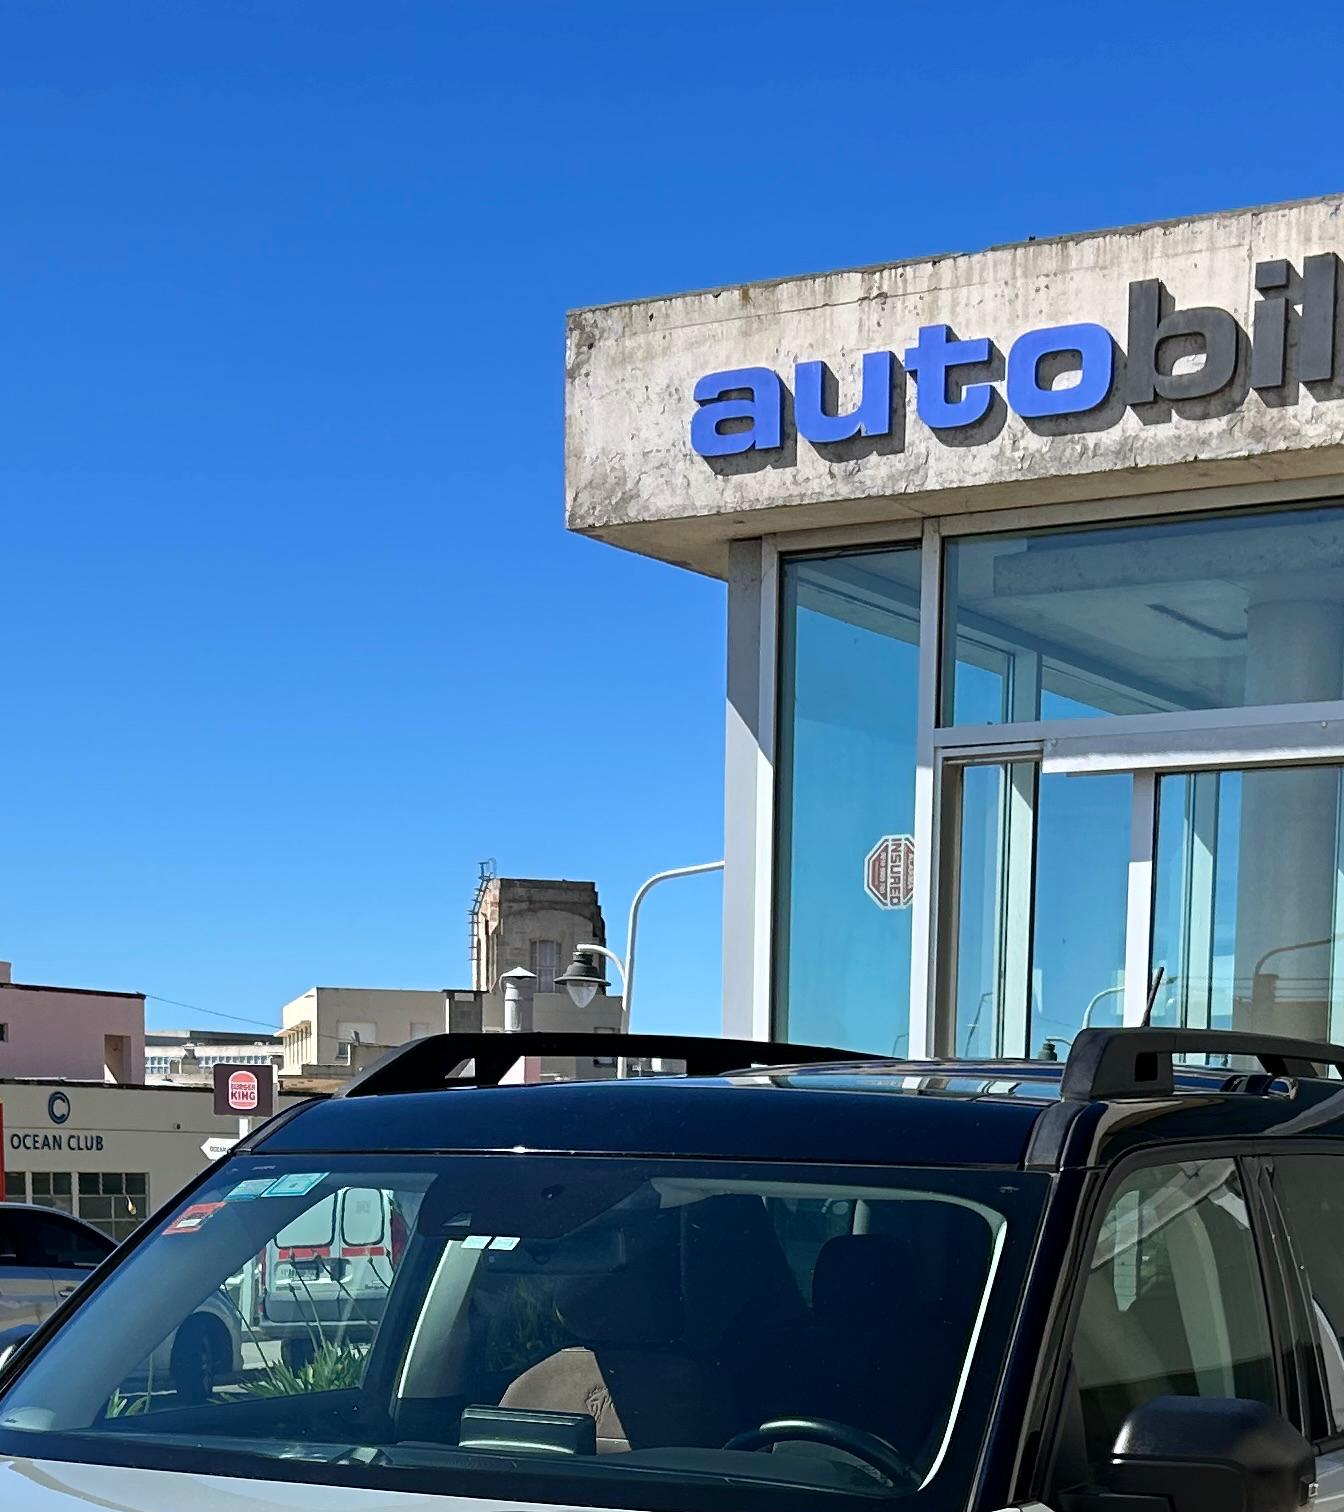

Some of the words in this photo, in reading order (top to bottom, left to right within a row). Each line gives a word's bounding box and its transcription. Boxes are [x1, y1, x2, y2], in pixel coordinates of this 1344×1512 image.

[889, 838, 902, 907] INSURED
[230, 1091, 256, 1101] KING
[10, 1133, 62, 1150] OCEAN
[67, 1134, 104, 1151] CLUB
